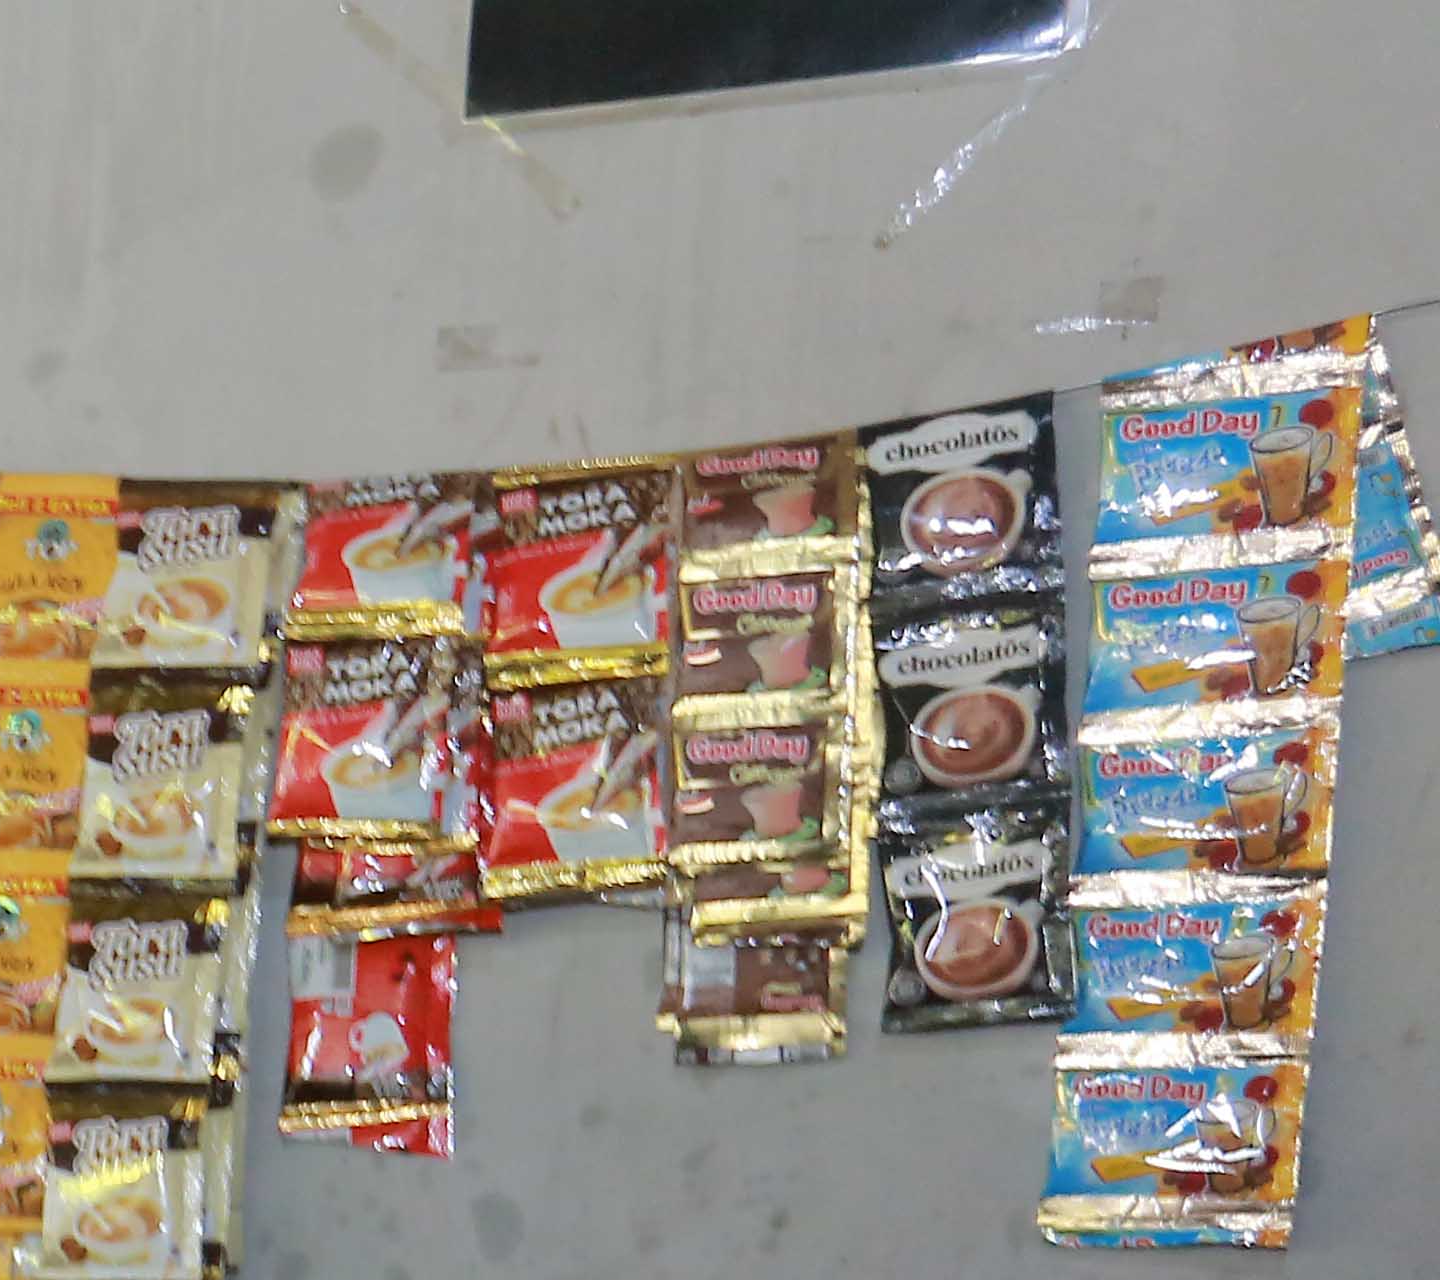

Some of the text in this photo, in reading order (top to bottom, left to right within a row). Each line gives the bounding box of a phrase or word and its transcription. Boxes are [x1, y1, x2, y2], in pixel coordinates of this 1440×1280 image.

[1122, 408, 1259, 442] Good Day
[692, 586, 764, 614] Good
[1110, 579, 1247, 611] Good Day
[1088, 912, 1223, 942] Good Day
[1149, 1074, 1208, 1103] Day
